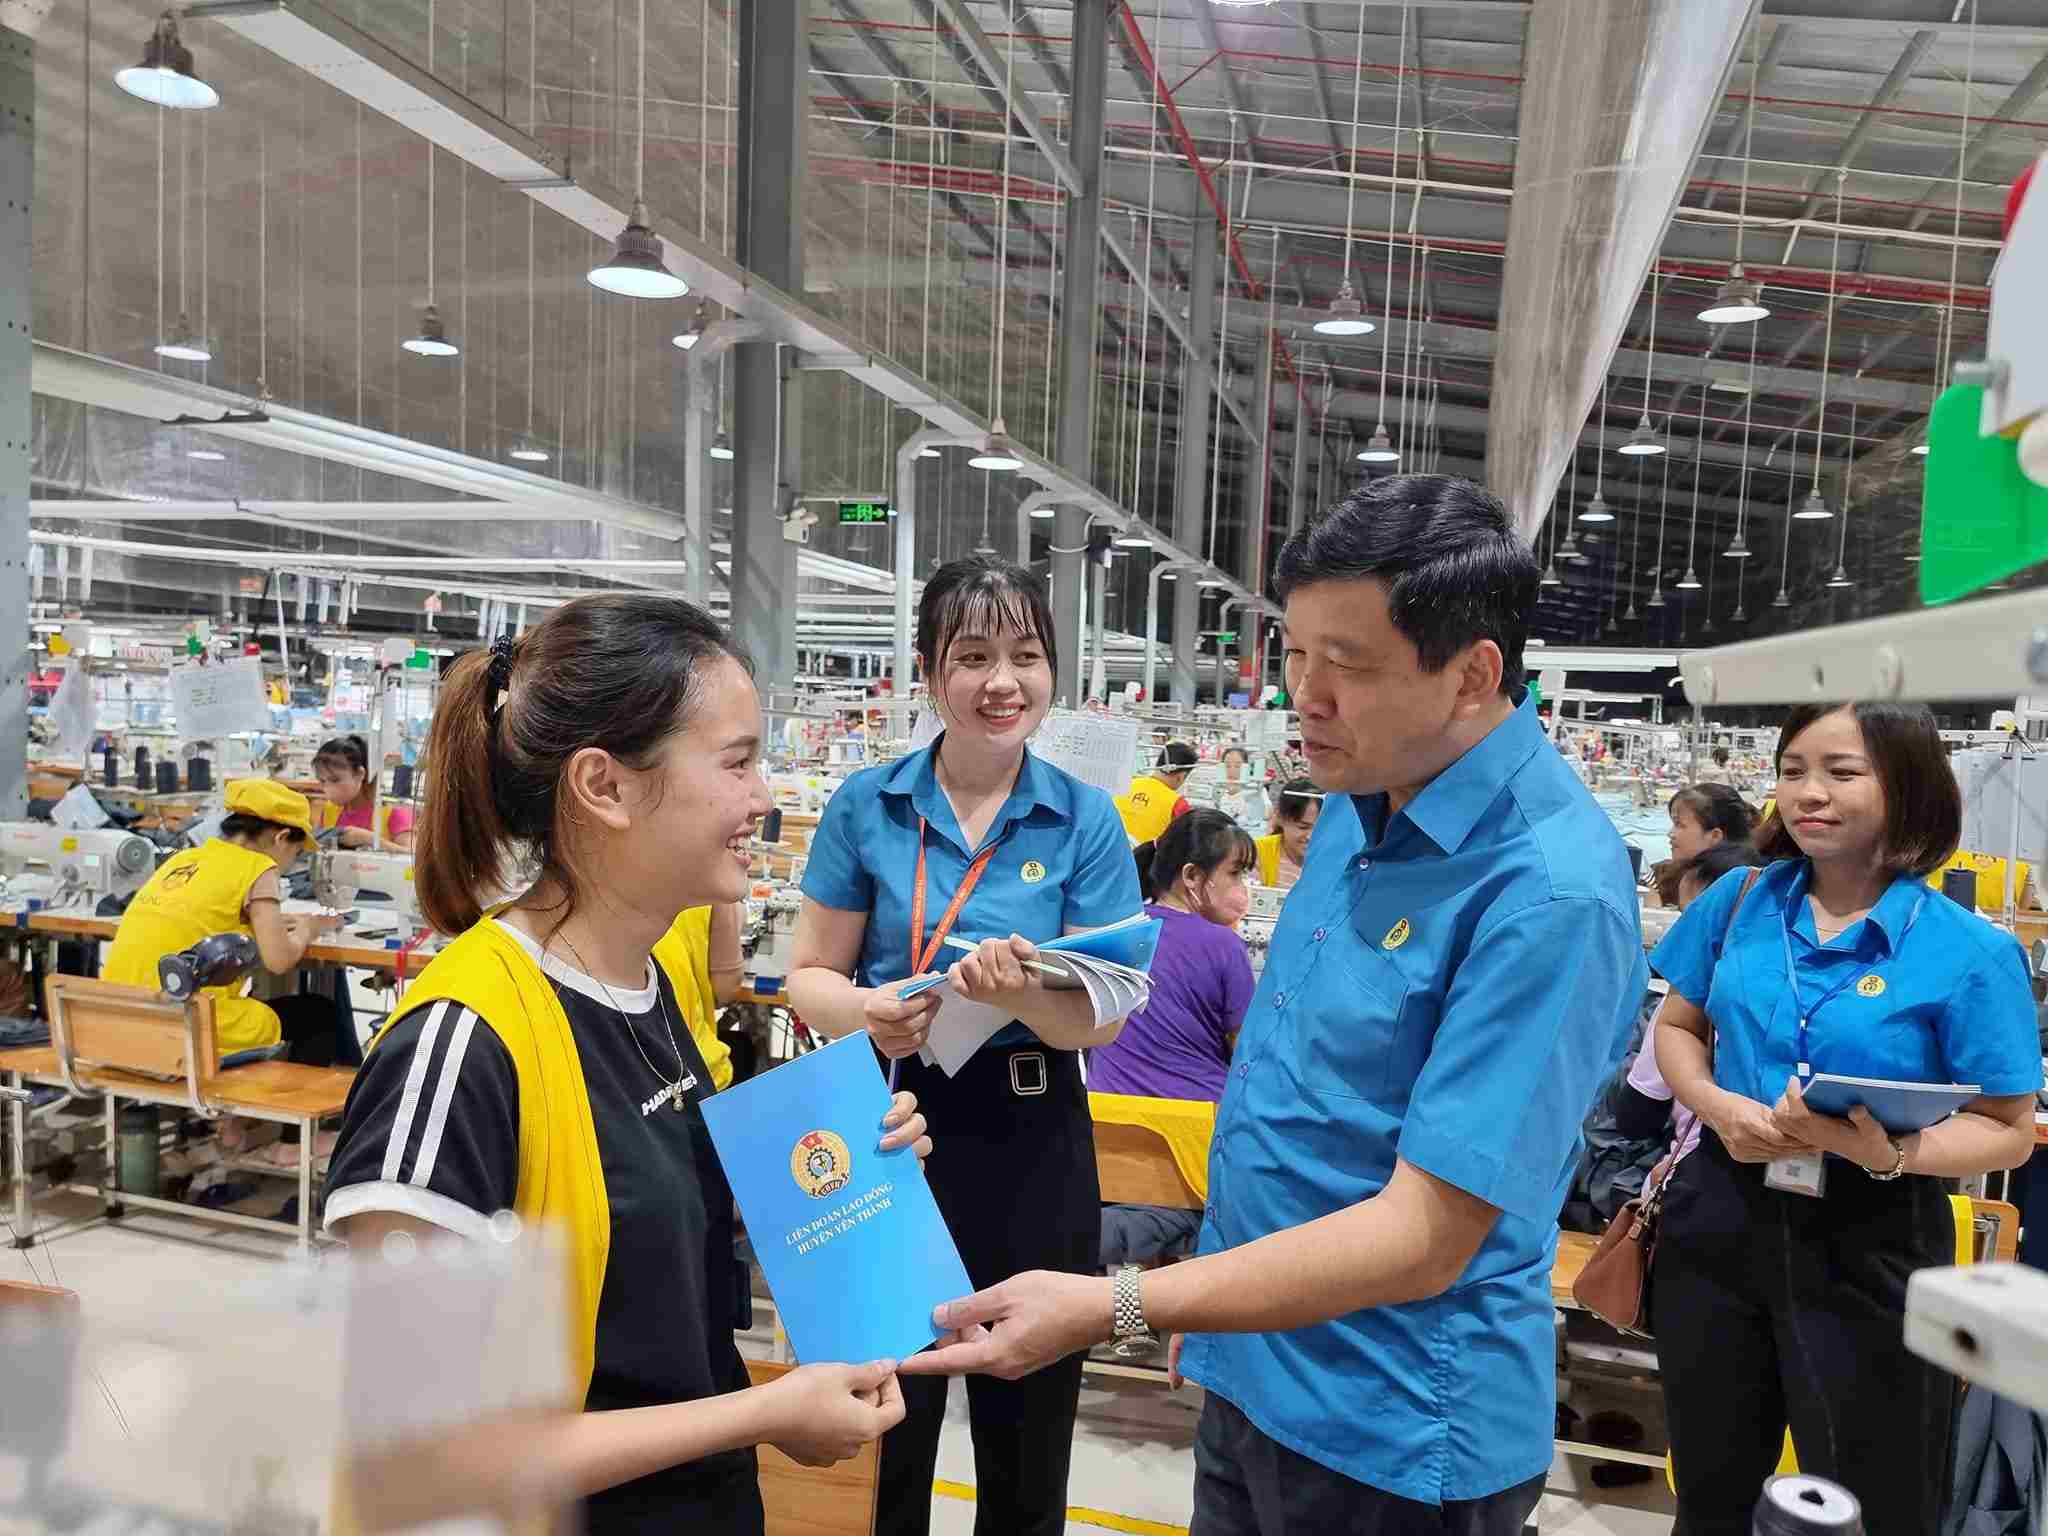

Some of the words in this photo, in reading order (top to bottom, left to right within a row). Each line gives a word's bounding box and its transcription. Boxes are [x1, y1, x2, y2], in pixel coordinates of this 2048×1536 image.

[785, 1224, 811, 1245] LIÊN
[811, 1208, 841, 1231] ĐOÀN
[841, 1198, 864, 1216] LAO
[834, 1216, 857, 1233] YÊN
[856, 1197, 893, 1222] THÀNH
